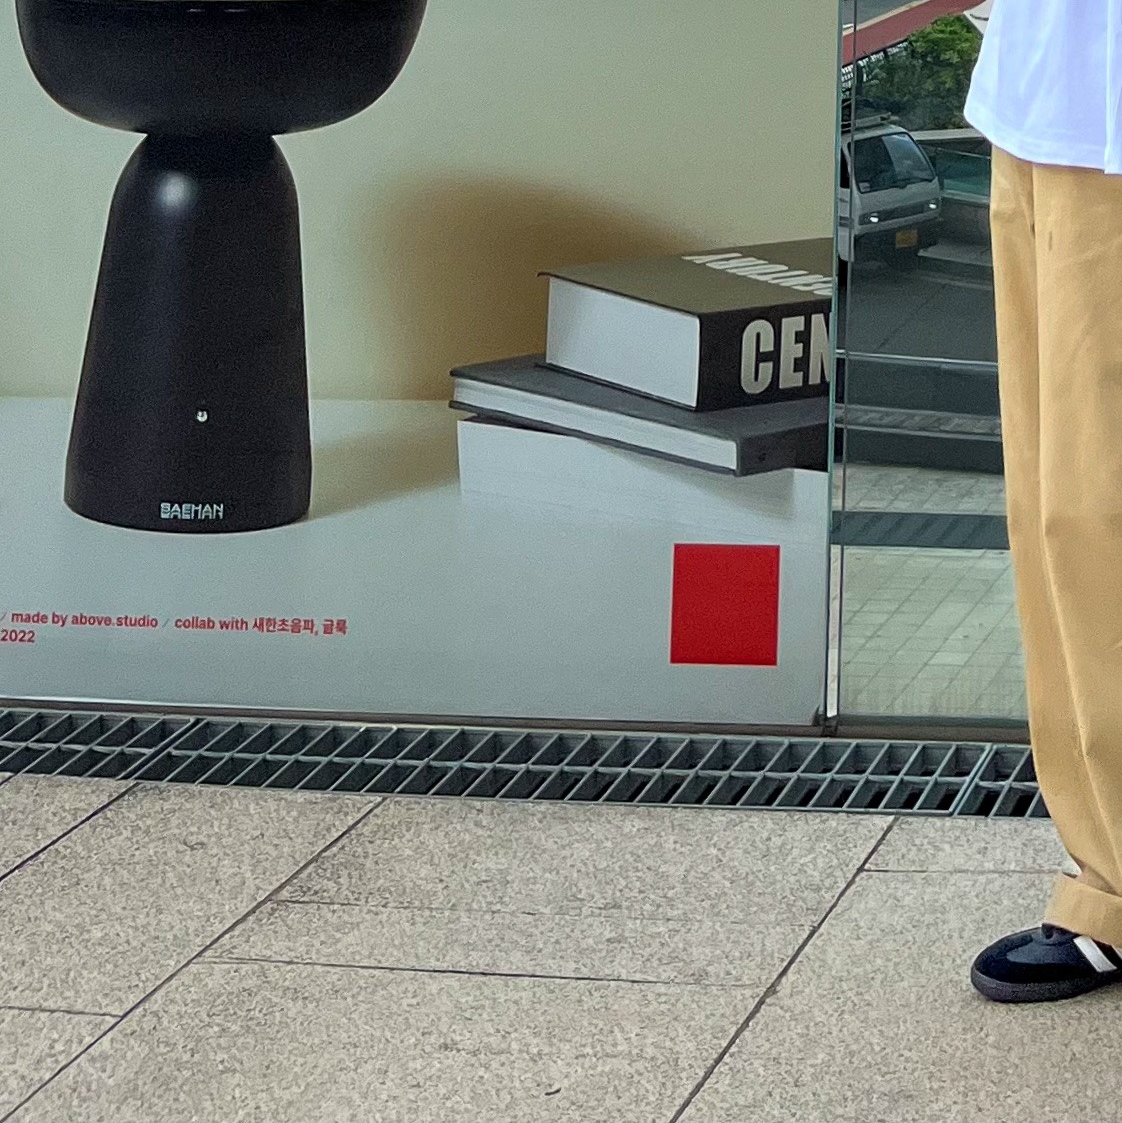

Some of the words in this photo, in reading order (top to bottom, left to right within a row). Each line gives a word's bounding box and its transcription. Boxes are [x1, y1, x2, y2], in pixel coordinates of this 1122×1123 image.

[11, 612, 48, 623] made
[52, 611, 68, 627] by
[174, 616, 215, 630] collab
[219, 617, 248, 631] with
[1, 630, 35, 643] 2022
